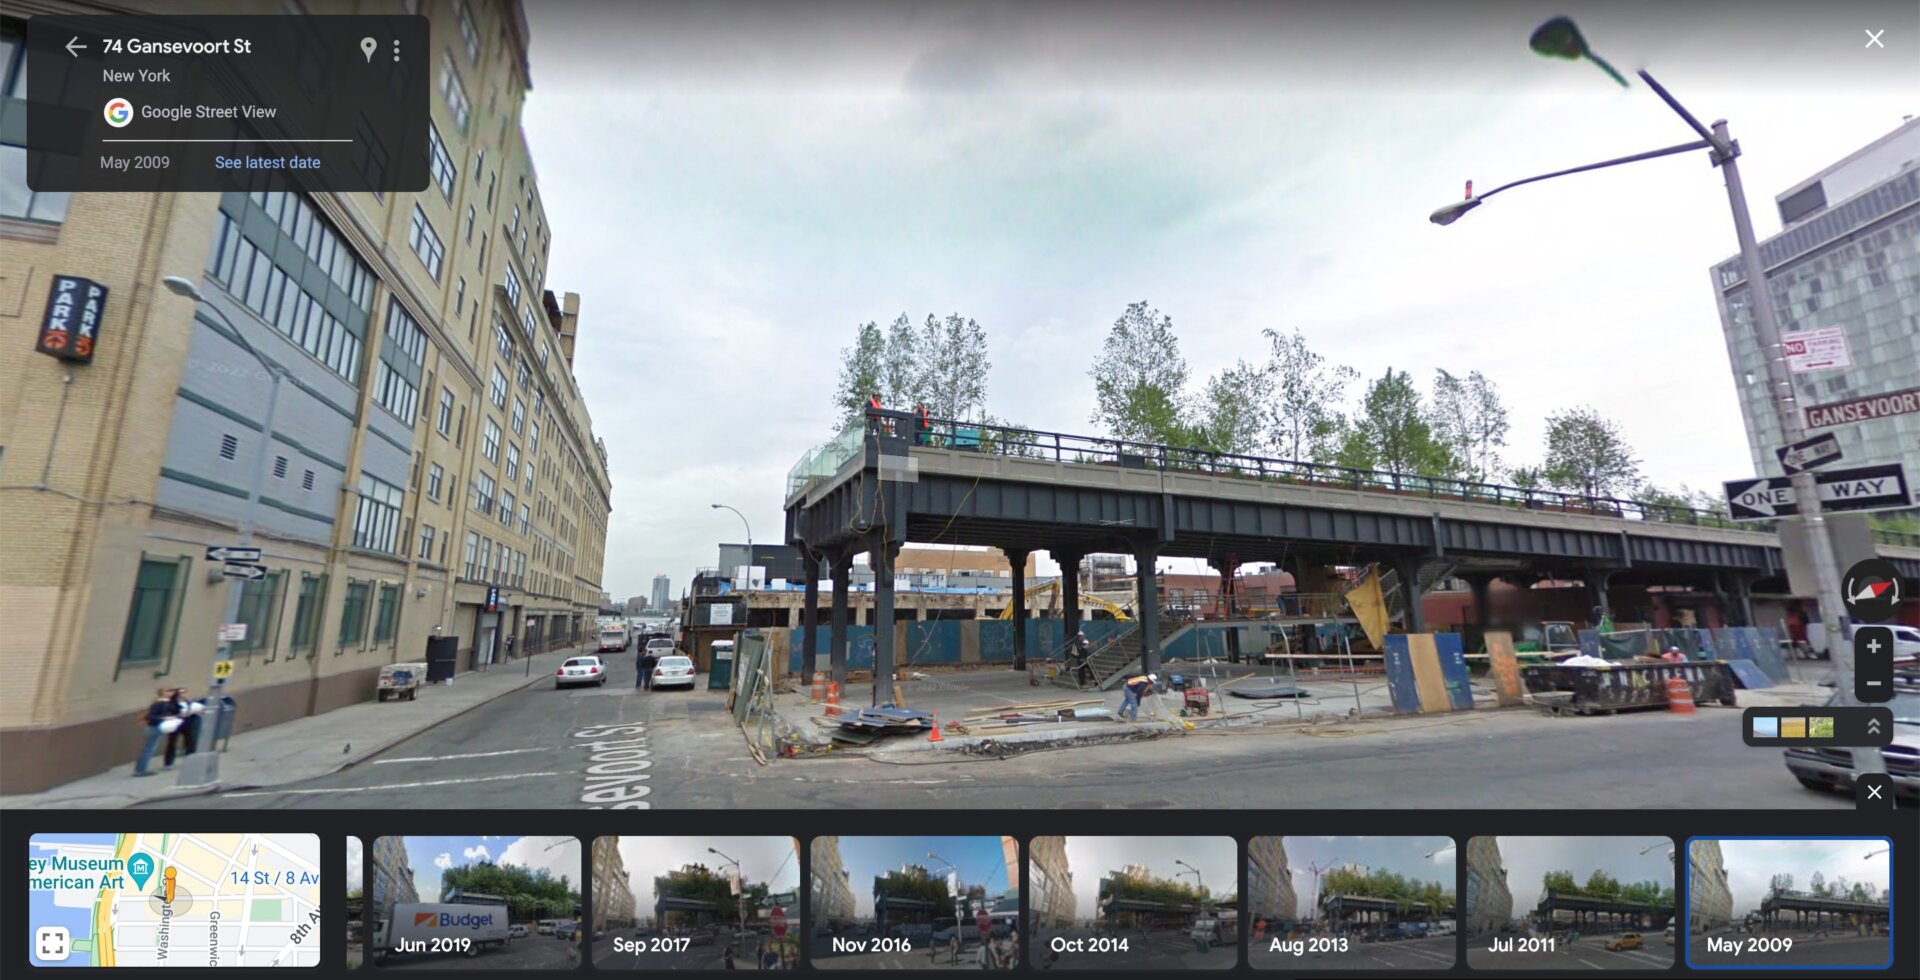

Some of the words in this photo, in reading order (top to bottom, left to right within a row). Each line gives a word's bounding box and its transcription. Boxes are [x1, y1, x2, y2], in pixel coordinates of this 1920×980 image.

[49, 279, 77, 331] PARK
[79, 286, 102, 338] PARK
[1786, 342, 1804, 354] NO
[1742, 489, 1788, 506] ONE
[1832, 479, 1886, 498] WAY
[439, 912, 494, 931] Budget
